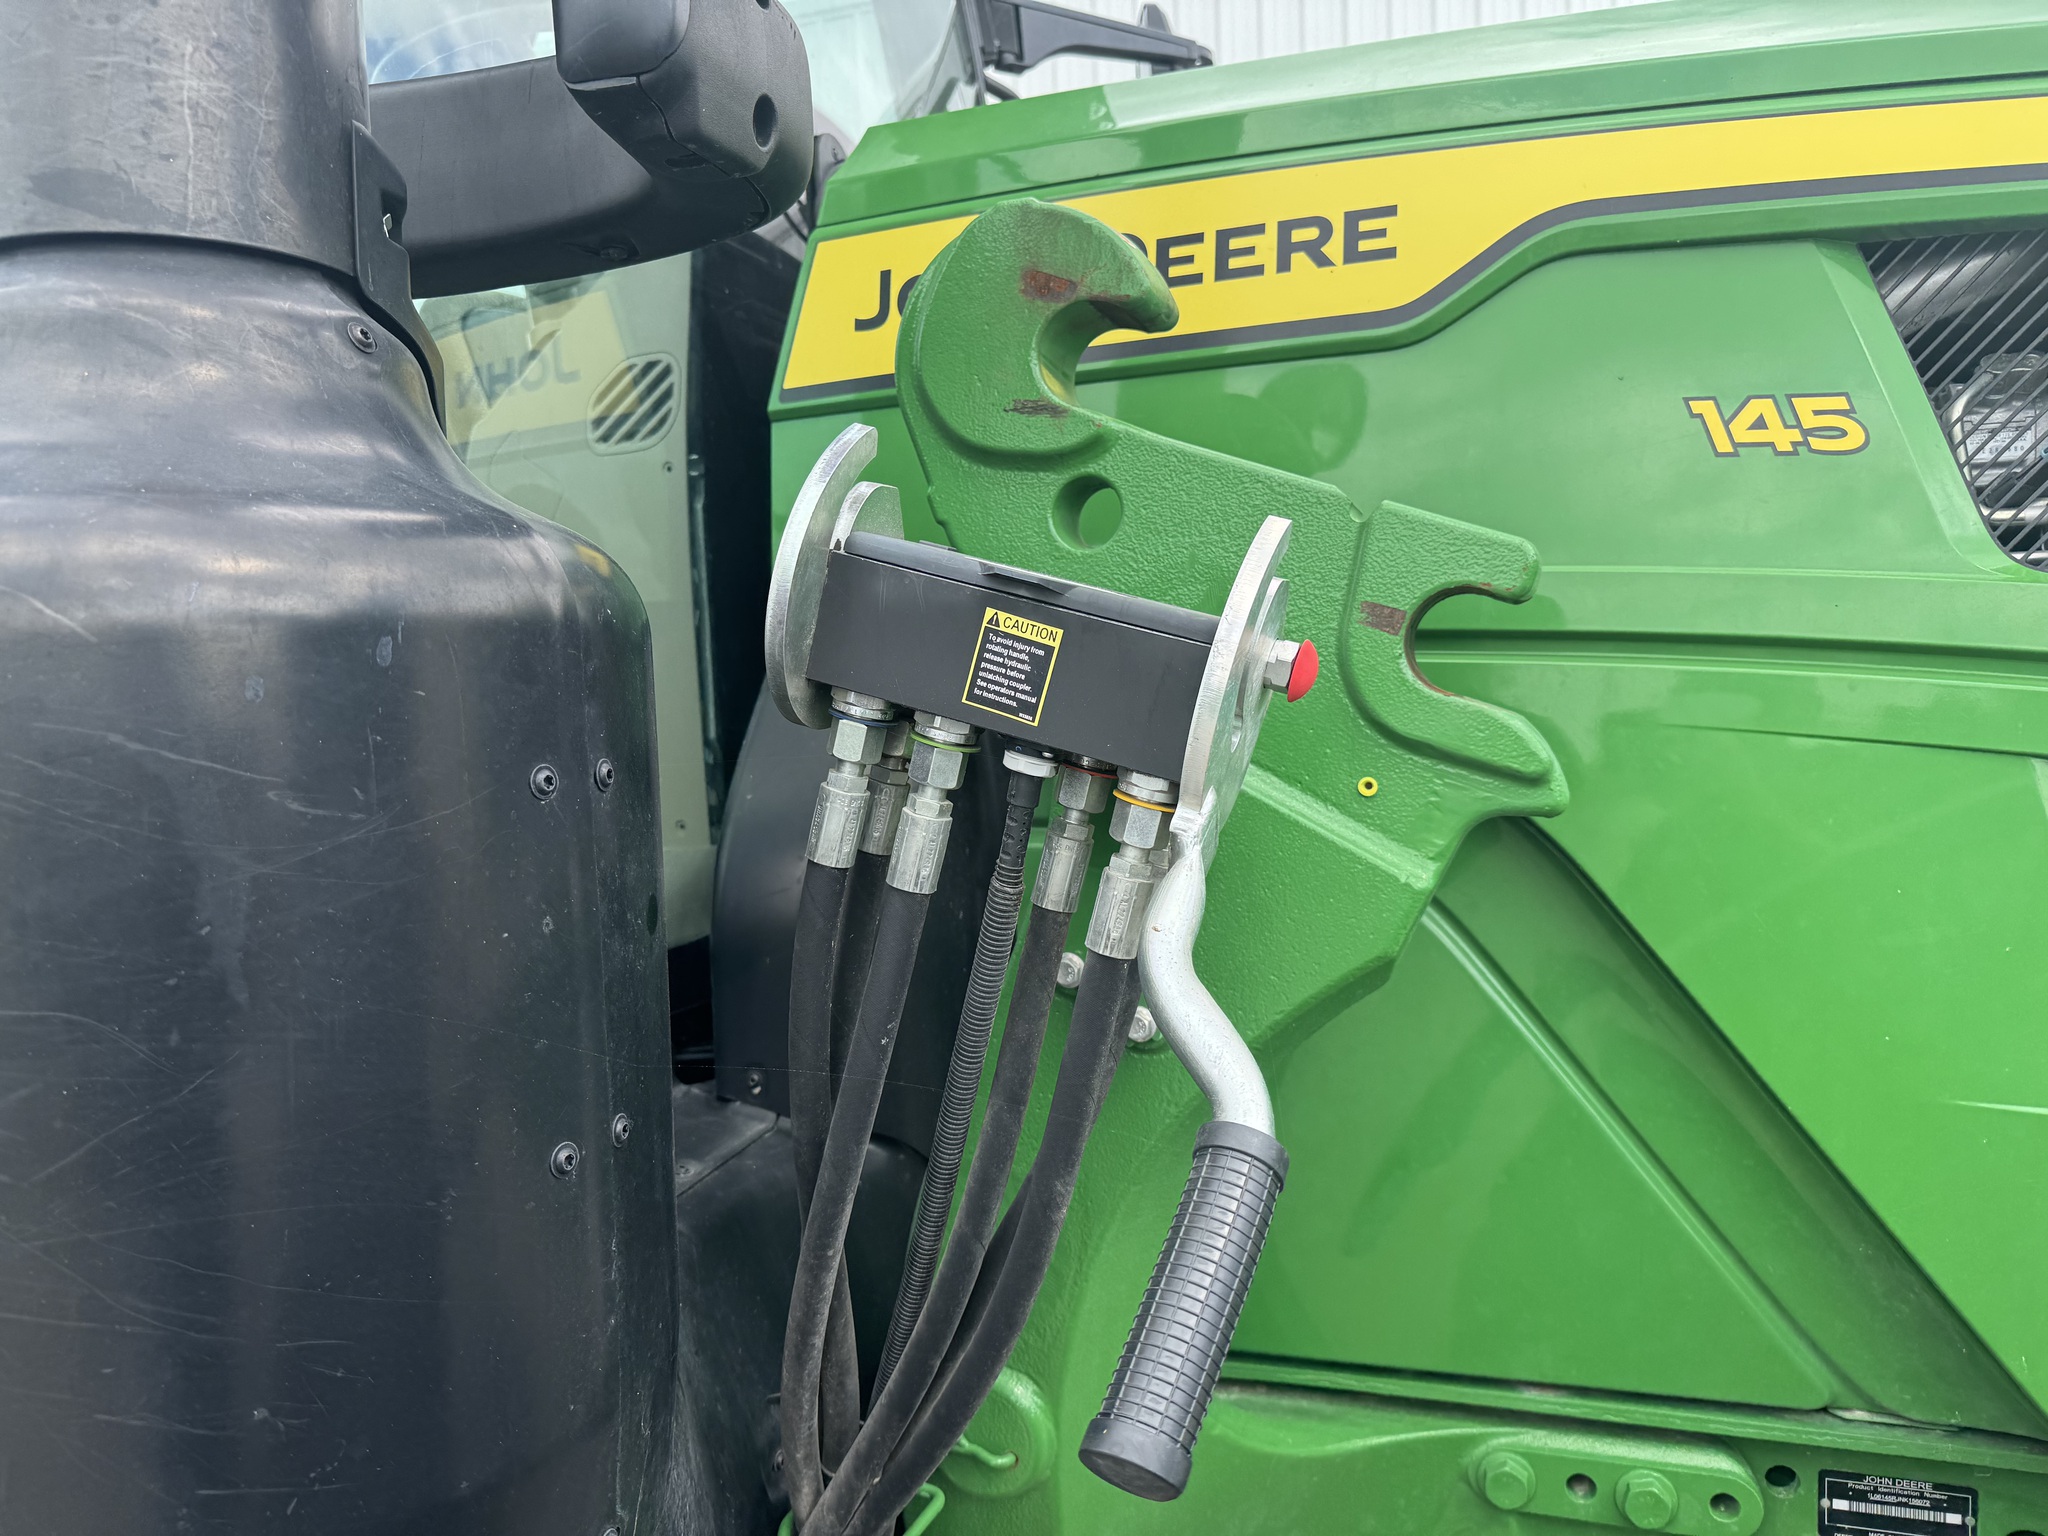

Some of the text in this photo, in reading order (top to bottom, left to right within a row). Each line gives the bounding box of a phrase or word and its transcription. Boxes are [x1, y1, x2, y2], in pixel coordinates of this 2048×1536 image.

[1682, 391, 1871, 458] 145
[1003, 616, 1058, 642] CAUTION
[985, 643, 1030, 662] rotating handle,
[988, 632, 1045, 656] To avoid injury from
[980, 661, 1026, 680] pressure before
[983, 652, 1032, 672] release hydraulic
[976, 678, 1037, 704] See operators manual
[978, 670, 1032, 693] unlatching coupler.
[973, 687, 1018, 708] for instructions.
[1847, 1482, 1949, 1500] Product Identification Number
[1863, 1475, 1933, 1491] JOHN DEERE
